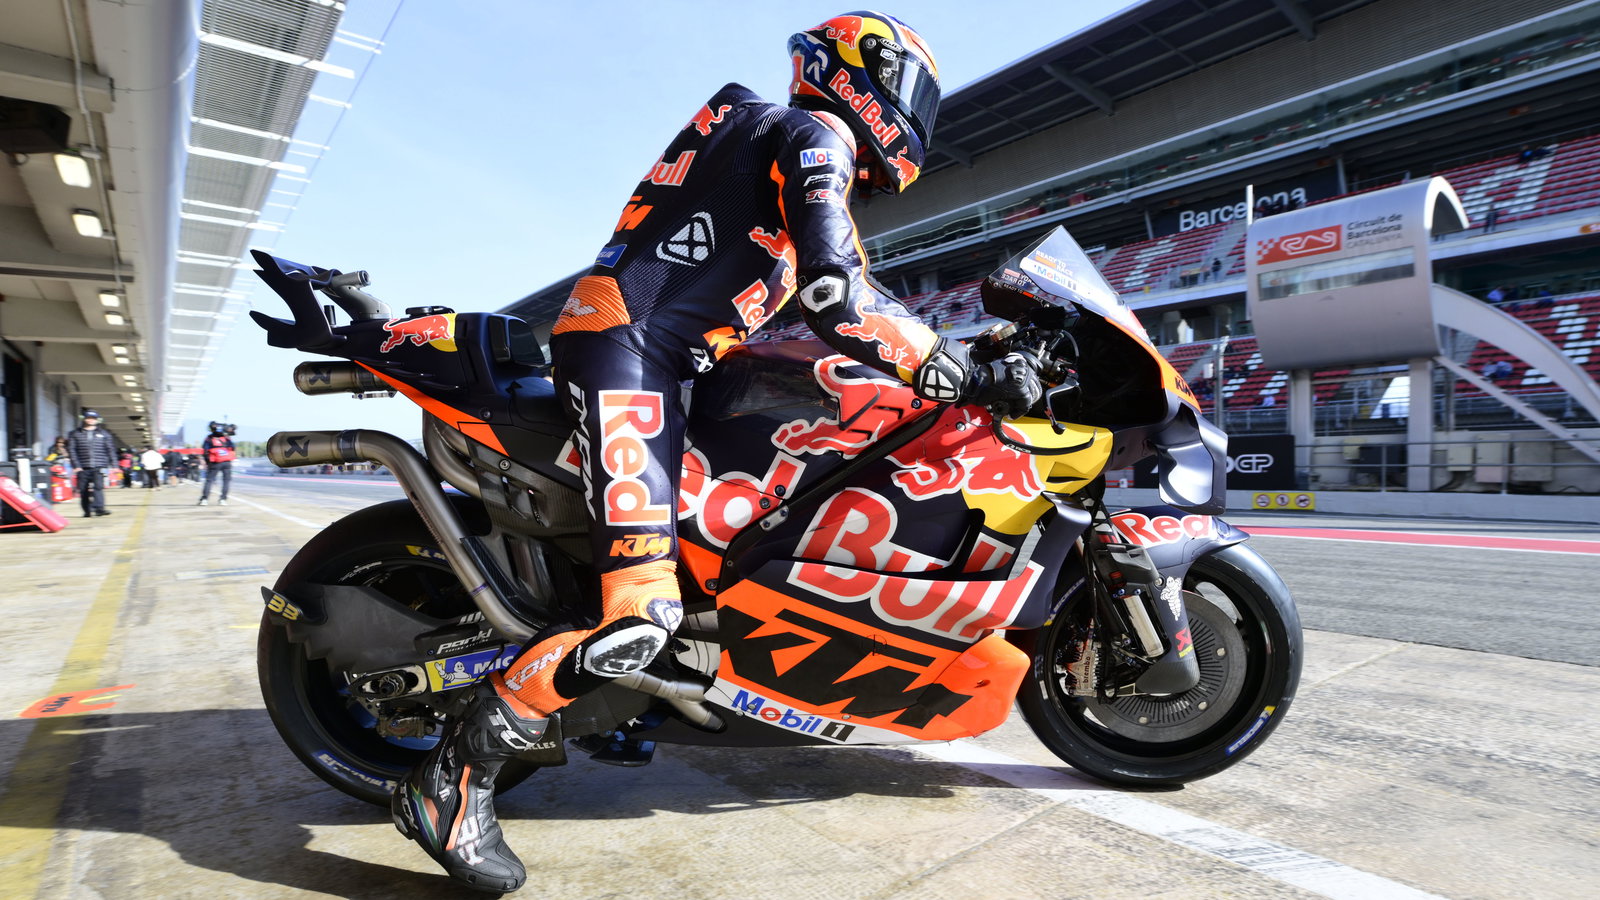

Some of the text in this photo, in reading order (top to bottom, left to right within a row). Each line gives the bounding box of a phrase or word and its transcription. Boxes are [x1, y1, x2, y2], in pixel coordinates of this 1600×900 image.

[829, 68, 871, 113] Red
[859, 100, 901, 148] Bull
[1178, 187, 1307, 232] Barceona
[1347, 213, 1403, 230] Circuit de
[1347, 223, 1403, 239] Barcelona
[598, 389, 671, 526] Red
[608, 533, 672, 557] KTM
[786, 487, 1045, 643] Bull
[268, 594, 301, 622] 33
[436, 628, 493, 655] pankl
[716, 604, 974, 729] KTM
[1082, 655, 1091, 684] brembo
[730, 690, 823, 734] Mobil
